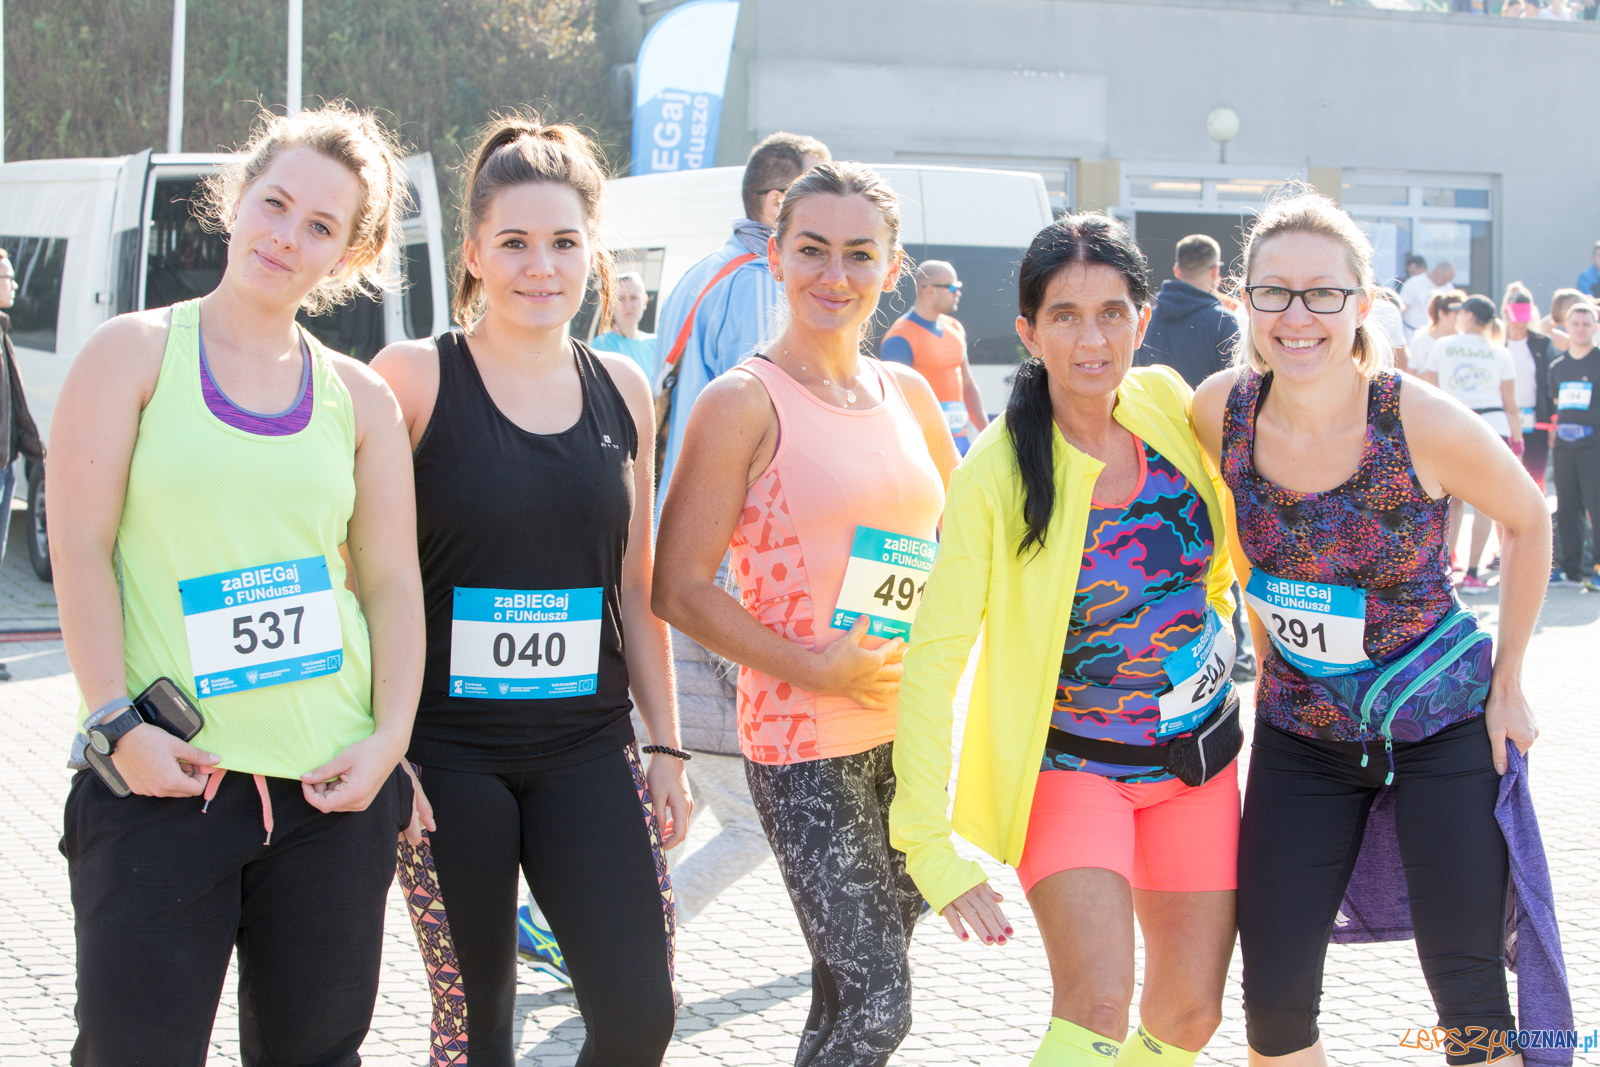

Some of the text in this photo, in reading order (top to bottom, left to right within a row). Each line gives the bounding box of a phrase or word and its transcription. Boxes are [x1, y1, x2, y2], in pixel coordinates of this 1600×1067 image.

[651, 91, 692, 171] EGaj
[684, 94, 709, 169] dusze
[882, 552, 934, 571] o FUNdusze
[883, 538, 937, 562] zaBIEGaj
[221, 564, 300, 592] zaBIEGaj
[224, 583, 301, 606] o FUNdusze
[493, 593, 570, 611] zaBIEGaj
[1266, 581, 1332, 603] zaBIEGaj
[1266, 594, 1331, 612] o FUNdusze
[493, 610, 569, 621] o FUNdusze
[232, 606, 305, 655] 537
[1272, 613, 1327, 653] 291
[492, 632, 566, 668] 040
[1191, 652, 1226, 704] 294
